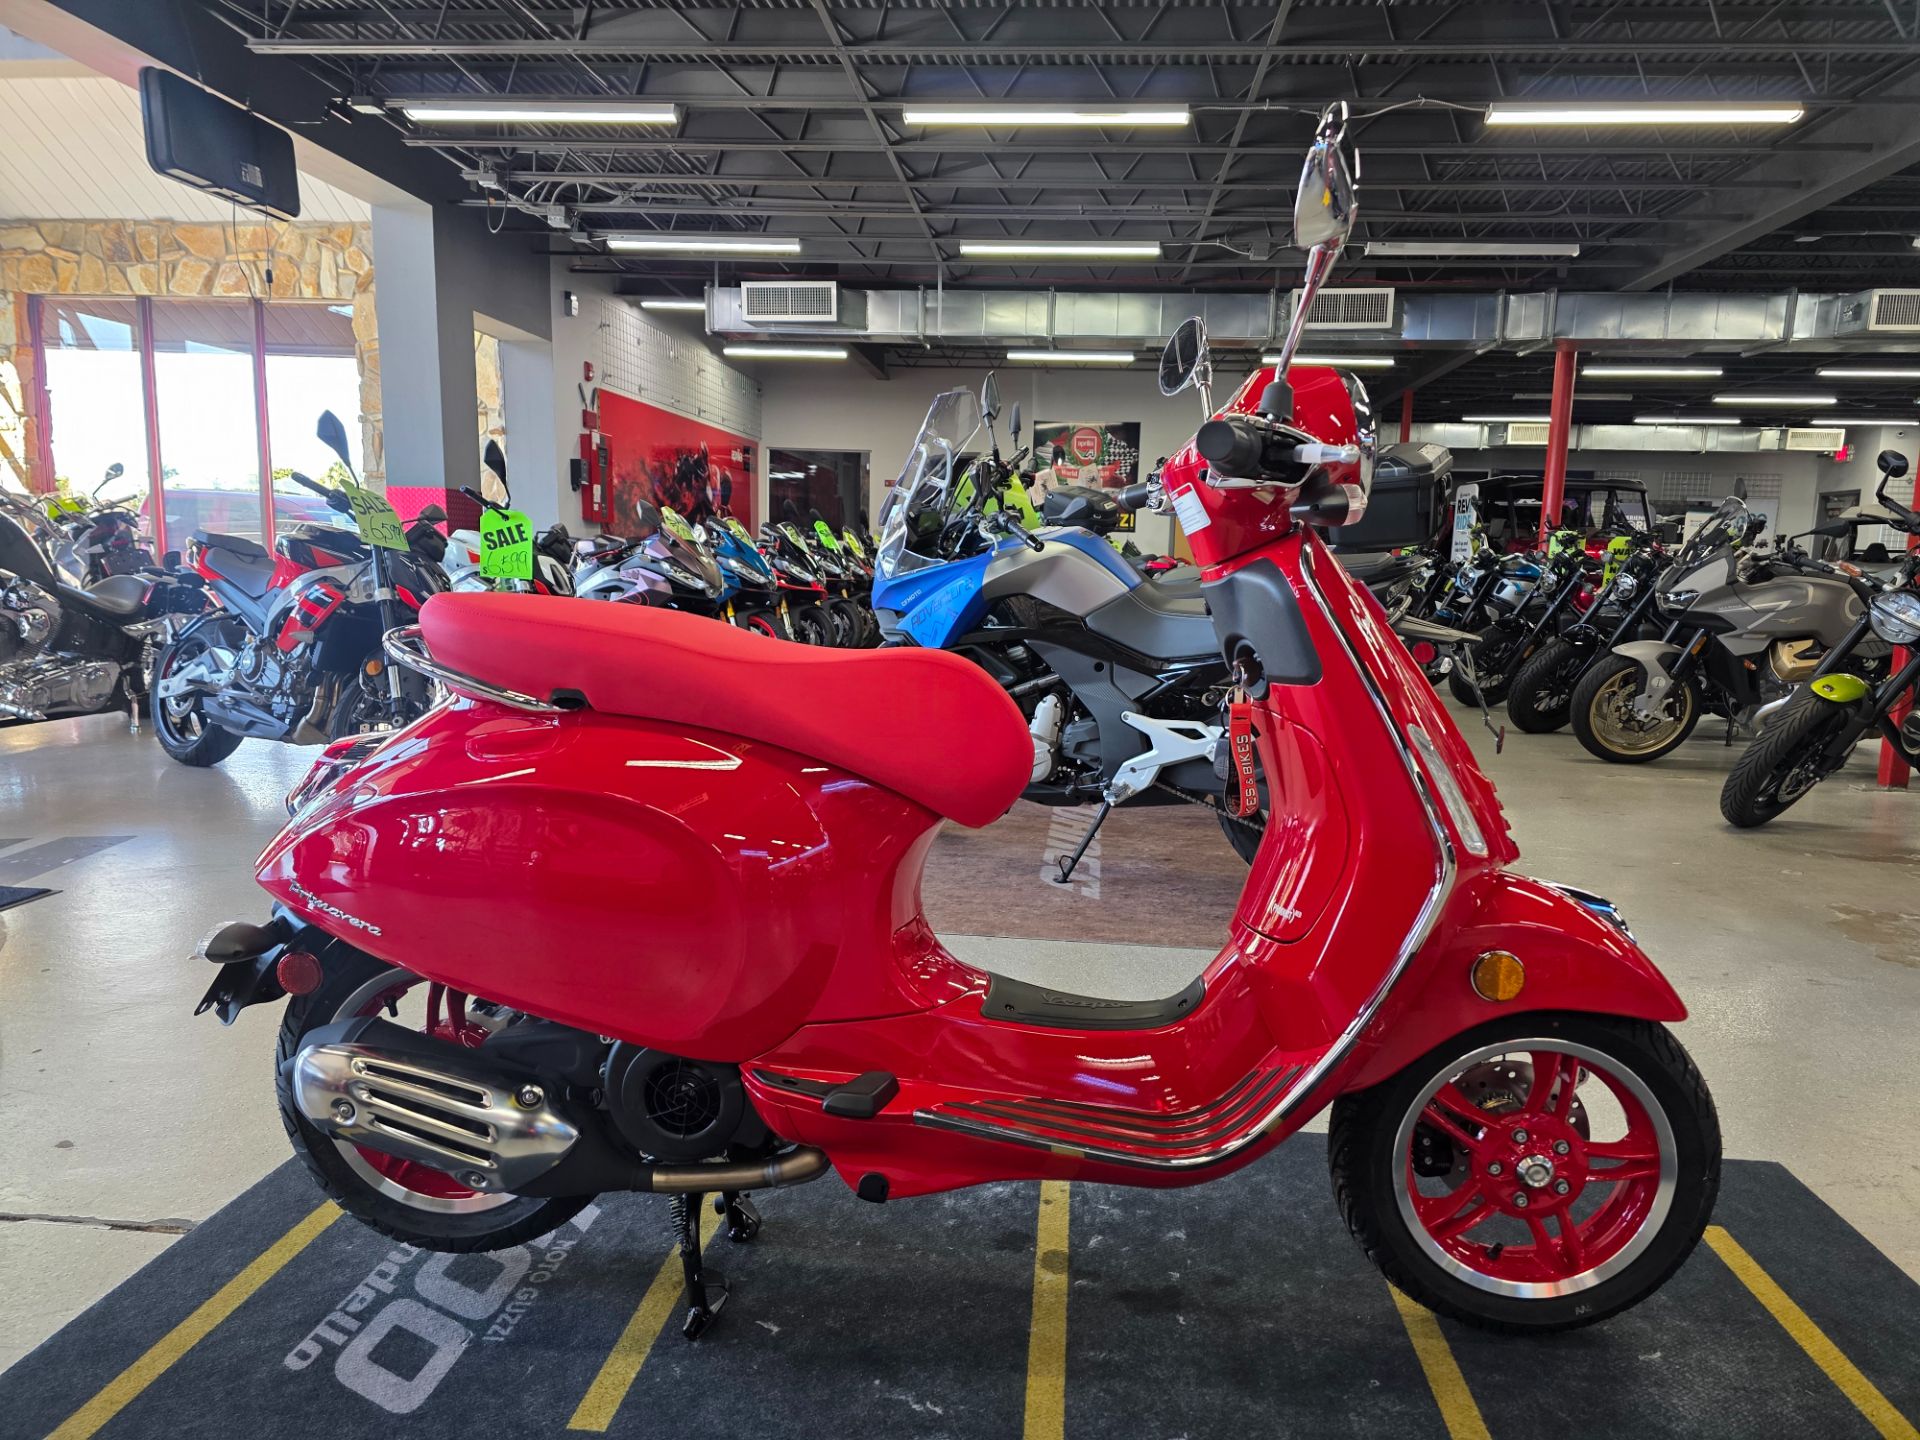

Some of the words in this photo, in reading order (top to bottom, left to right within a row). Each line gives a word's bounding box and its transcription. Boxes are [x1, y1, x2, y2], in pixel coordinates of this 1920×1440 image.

[351, 496, 393, 515] SALE
[483, 523, 528, 550] SALE
[1236, 734, 1253, 775] BIKES
[1245, 789, 1257, 815] KES
[289, 880, 382, 936] Primavera
[529, 1240, 578, 1283] MOTO
[284, 1242, 421, 1371] ndello
[482, 1287, 539, 1341] GUZZI
